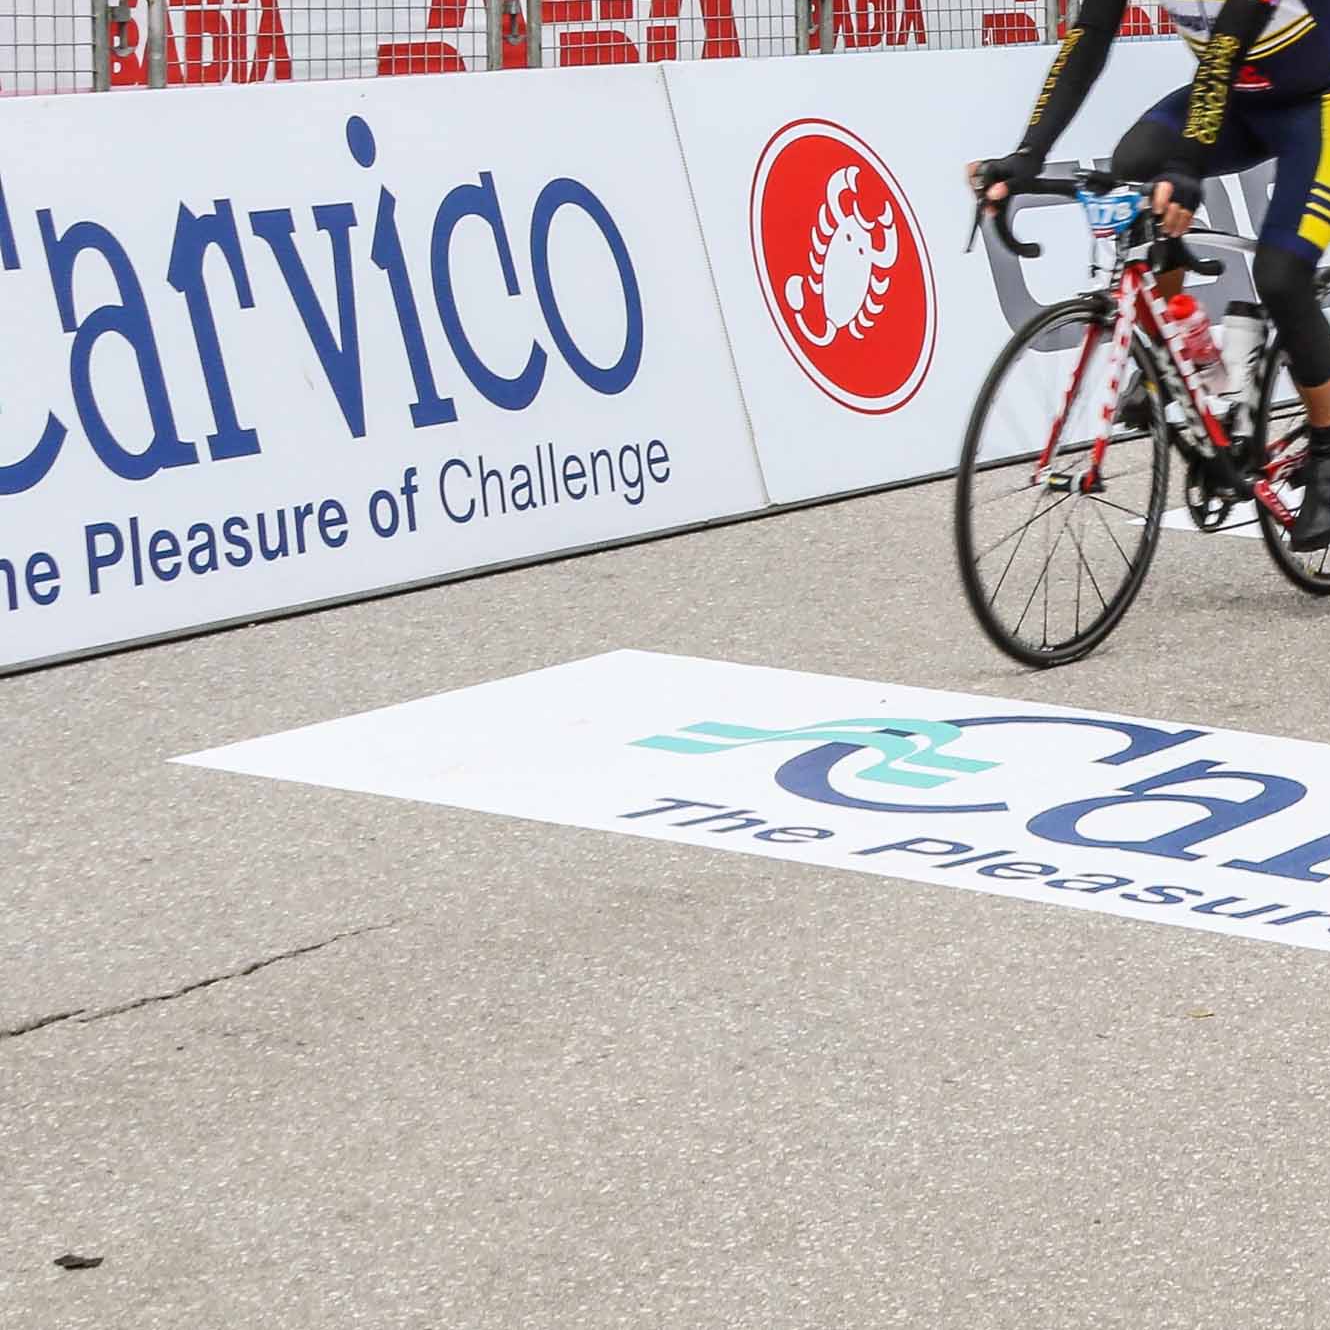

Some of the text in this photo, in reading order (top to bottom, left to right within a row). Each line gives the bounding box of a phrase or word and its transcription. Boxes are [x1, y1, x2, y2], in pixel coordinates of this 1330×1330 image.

[85, 500, 348, 595] Pleasure
[370, 467, 419, 538] of
[439, 439, 671, 524] Challenge
[617, 797, 836, 846] The
